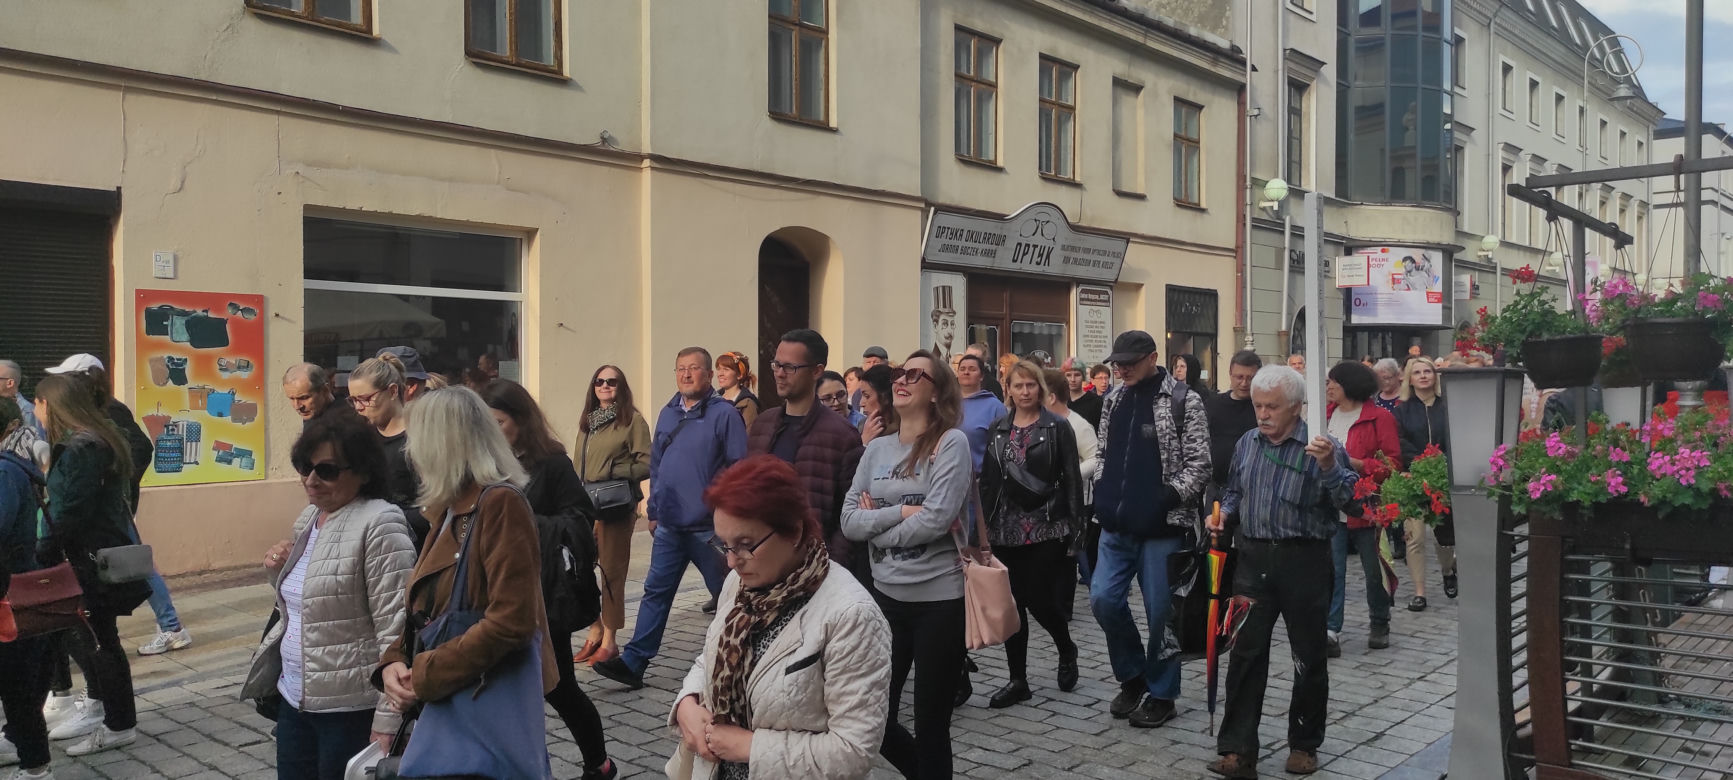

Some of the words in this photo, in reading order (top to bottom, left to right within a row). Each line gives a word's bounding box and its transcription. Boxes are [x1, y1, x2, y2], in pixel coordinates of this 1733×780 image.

[935, 225, 964, 242] OPTYKA
[965, 229, 1007, 247] OKULAROWA
[1012, 242, 1055, 267] OPTYK
